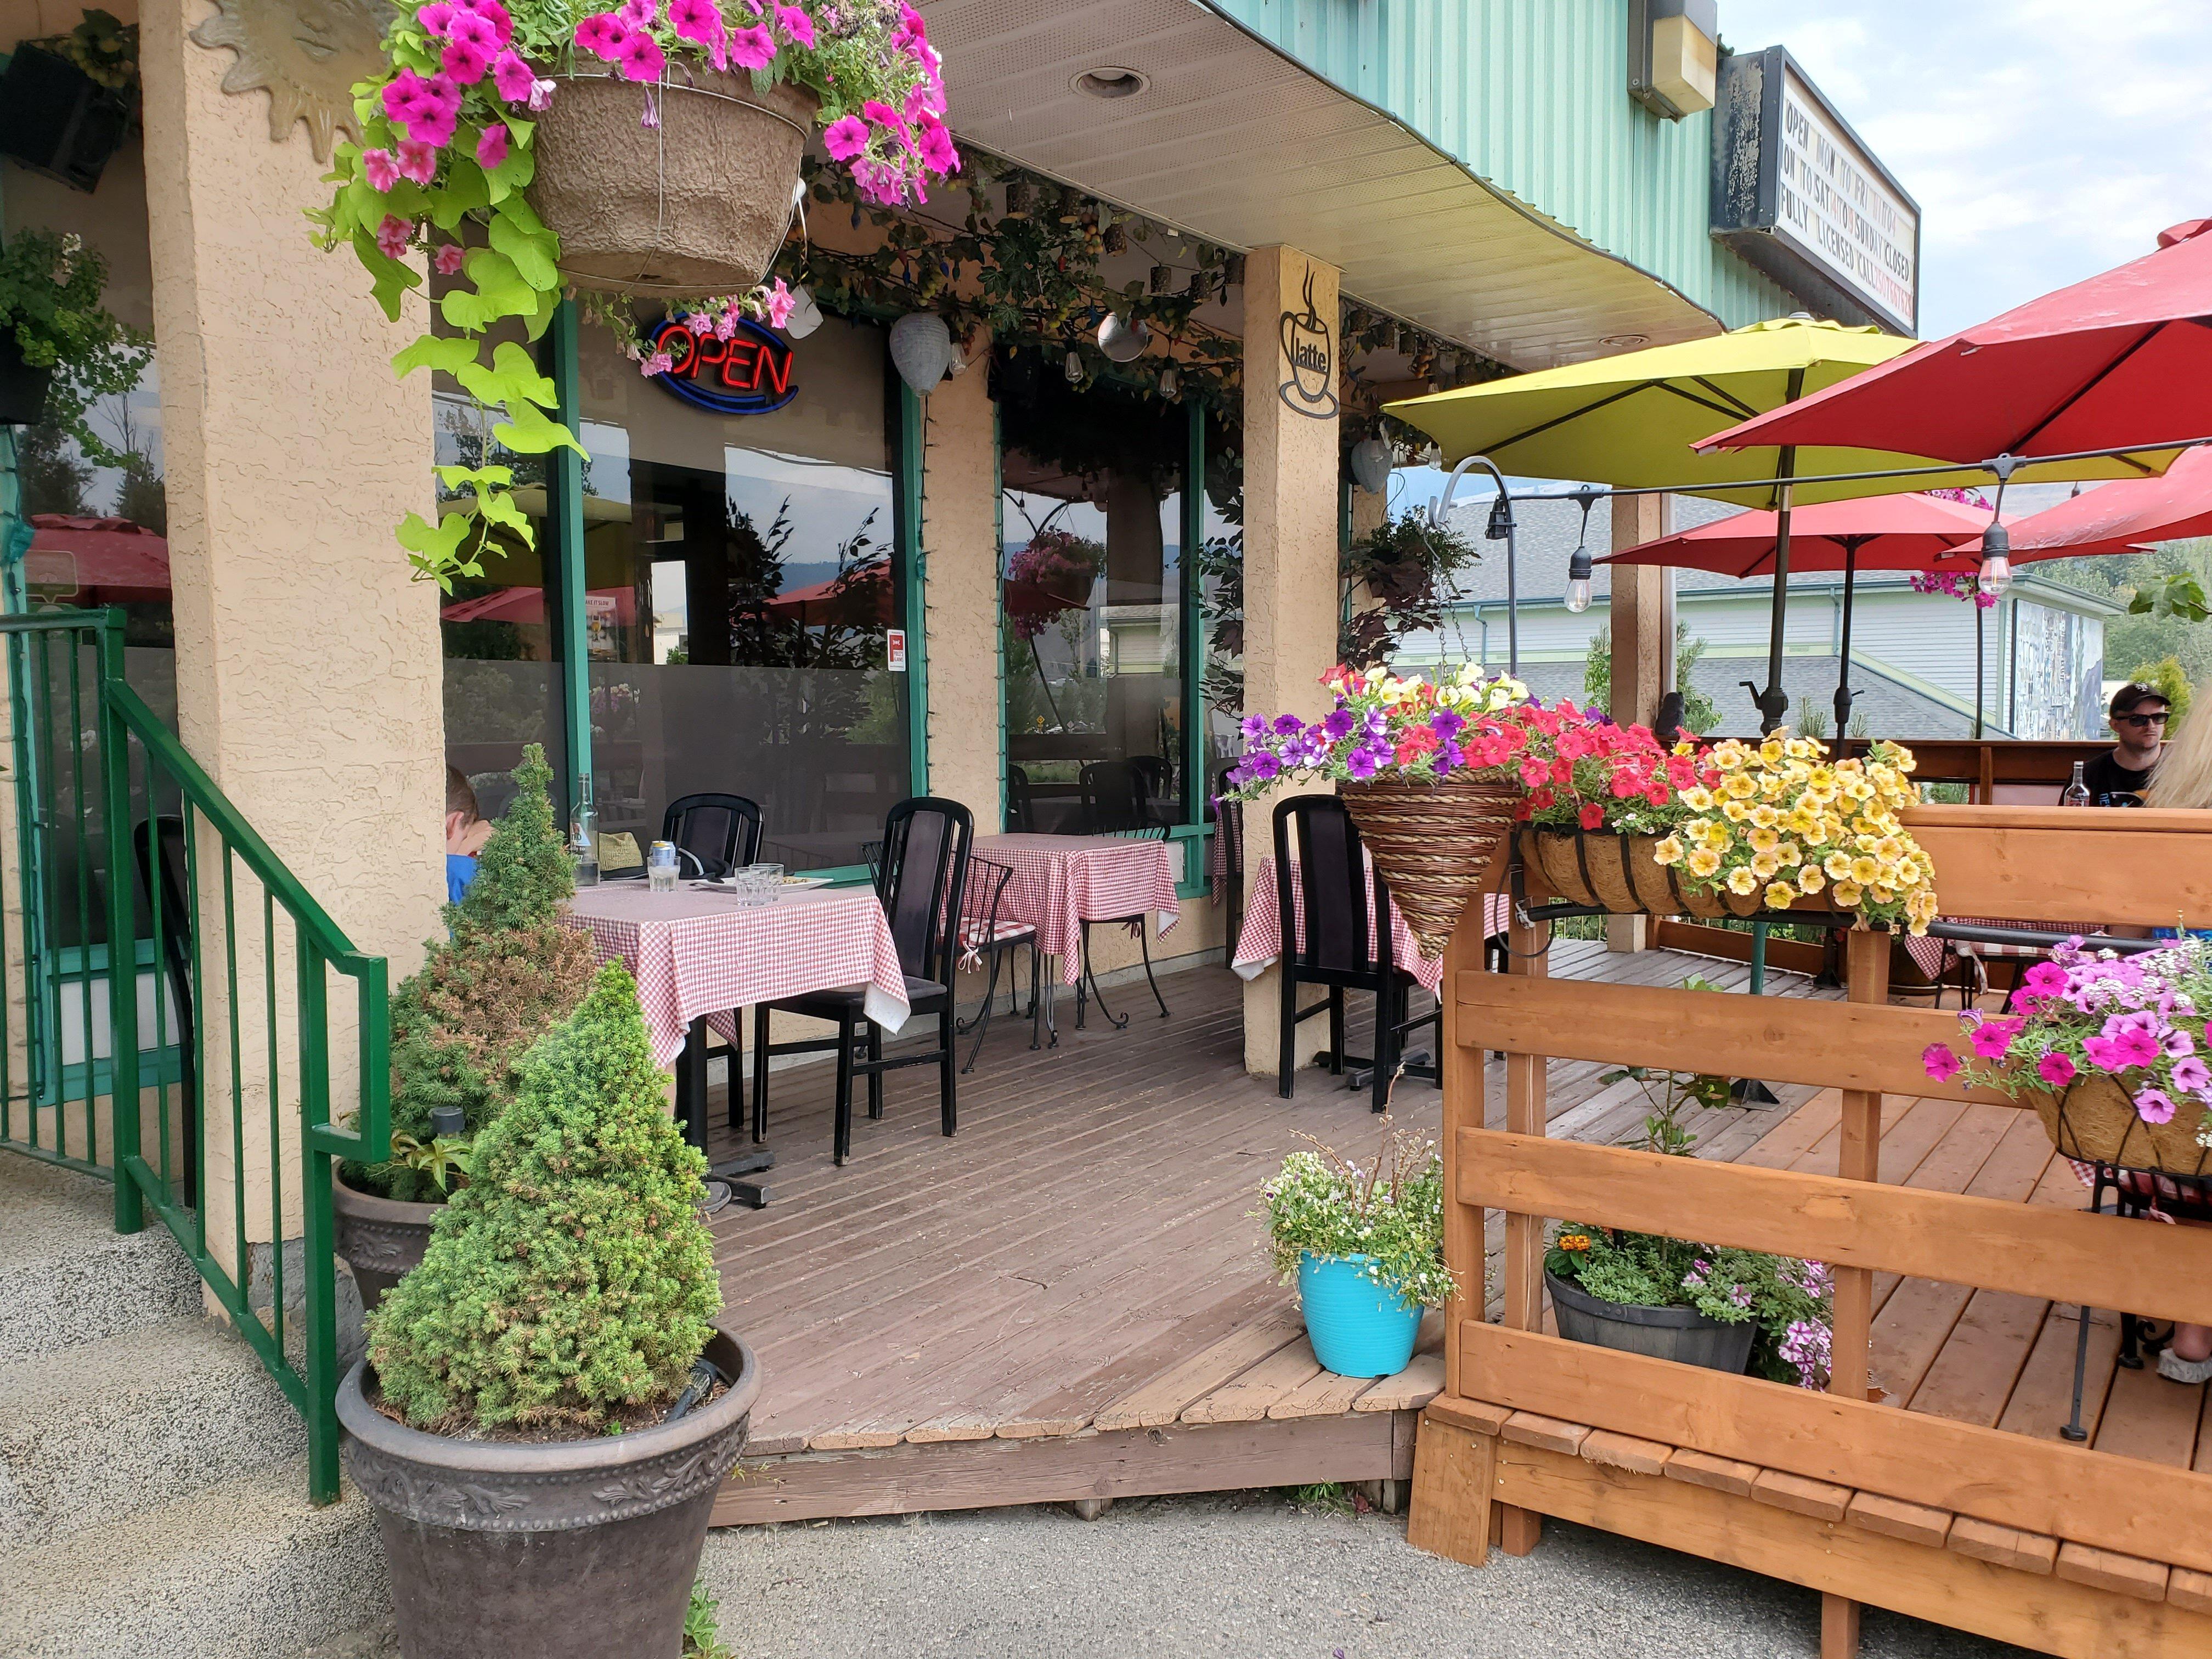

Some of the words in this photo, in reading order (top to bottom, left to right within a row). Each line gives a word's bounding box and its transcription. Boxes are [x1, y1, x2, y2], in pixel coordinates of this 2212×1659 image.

[1787, 102, 1809, 151] OPEN
[1817, 134, 1835, 178] MON
[1841, 158, 1851, 193] TO
[1855, 174, 1869, 211] FRI
[1781, 144, 1795, 182] ON
[1801, 159, 1812, 195] TO
[1815, 174, 1830, 212] SAT
[1856, 213, 1882, 260] SUNDAY
[1886, 241, 1909, 281] CLOSED
[1781, 182, 1808, 233] FULLY
[1817, 213, 1854, 270] LICENSED
[1859, 252, 1875, 289] CALL
[657, 325, 794, 394] OPEN
[1295, 337, 1326, 373] latte
